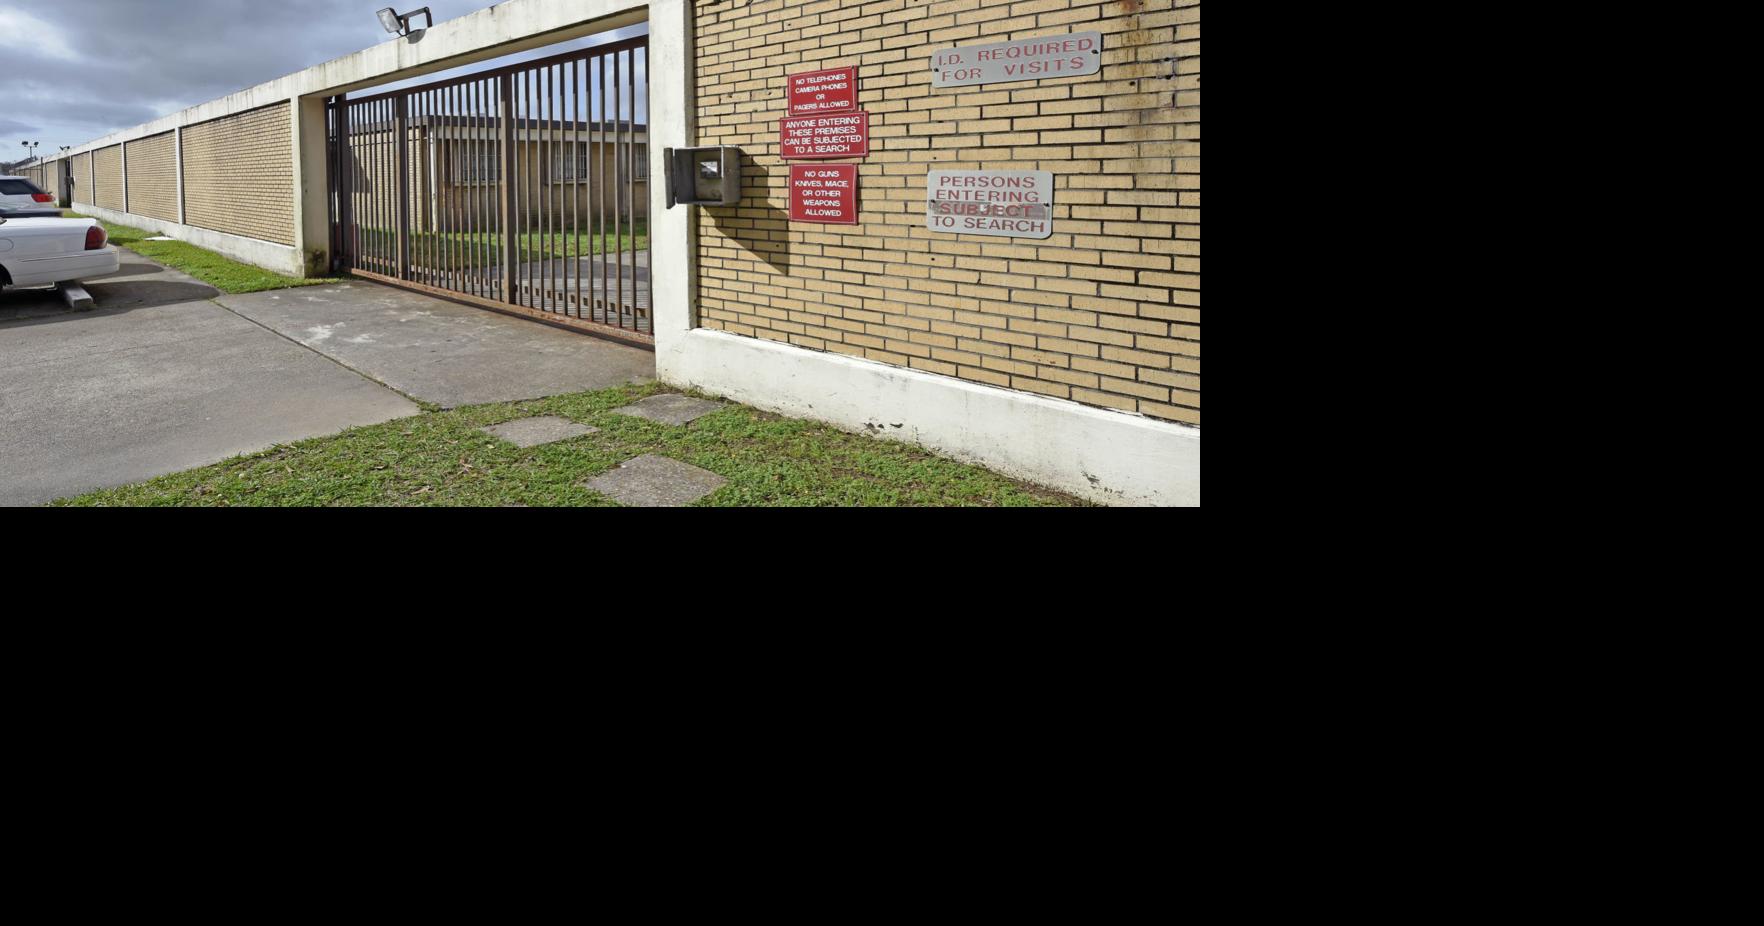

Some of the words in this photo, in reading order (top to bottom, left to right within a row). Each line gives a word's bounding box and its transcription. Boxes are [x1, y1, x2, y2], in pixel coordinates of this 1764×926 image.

[938, 54, 964, 66] I.D.
[977, 38, 1093, 62] REQUIRED
[941, 68, 982, 82] FOR
[1004, 56, 1084, 76] VISITS
[807, 74, 846, 83] TELEPHONES
[795, 85, 820, 94] CAMERA
[821, 82, 847, 91] PHONES
[819, 100, 849, 109] ALLOWED
[785, 120, 816, 129] ANYONE
[818, 116, 860, 126] ENTERING
[789, 128, 812, 137] THESE
[815, 126, 856, 135] PREMISES
[784, 138, 799, 146] CAN
[814, 135, 862, 144] SUBJECTED
[815, 145, 850, 153] SEARCH
[818, 170, 840, 178] GUNS
[795, 180, 823, 188] KNIVES,
[940, 176, 1035, 188] PERSONS
[936, 189, 1039, 203] ENTERING
[803, 199, 840, 207] WEAPONS
[940, 202, 1034, 217] SUBJECT
[932, 215, 955, 228] TO
[964, 217, 1044, 233] SEARCH
